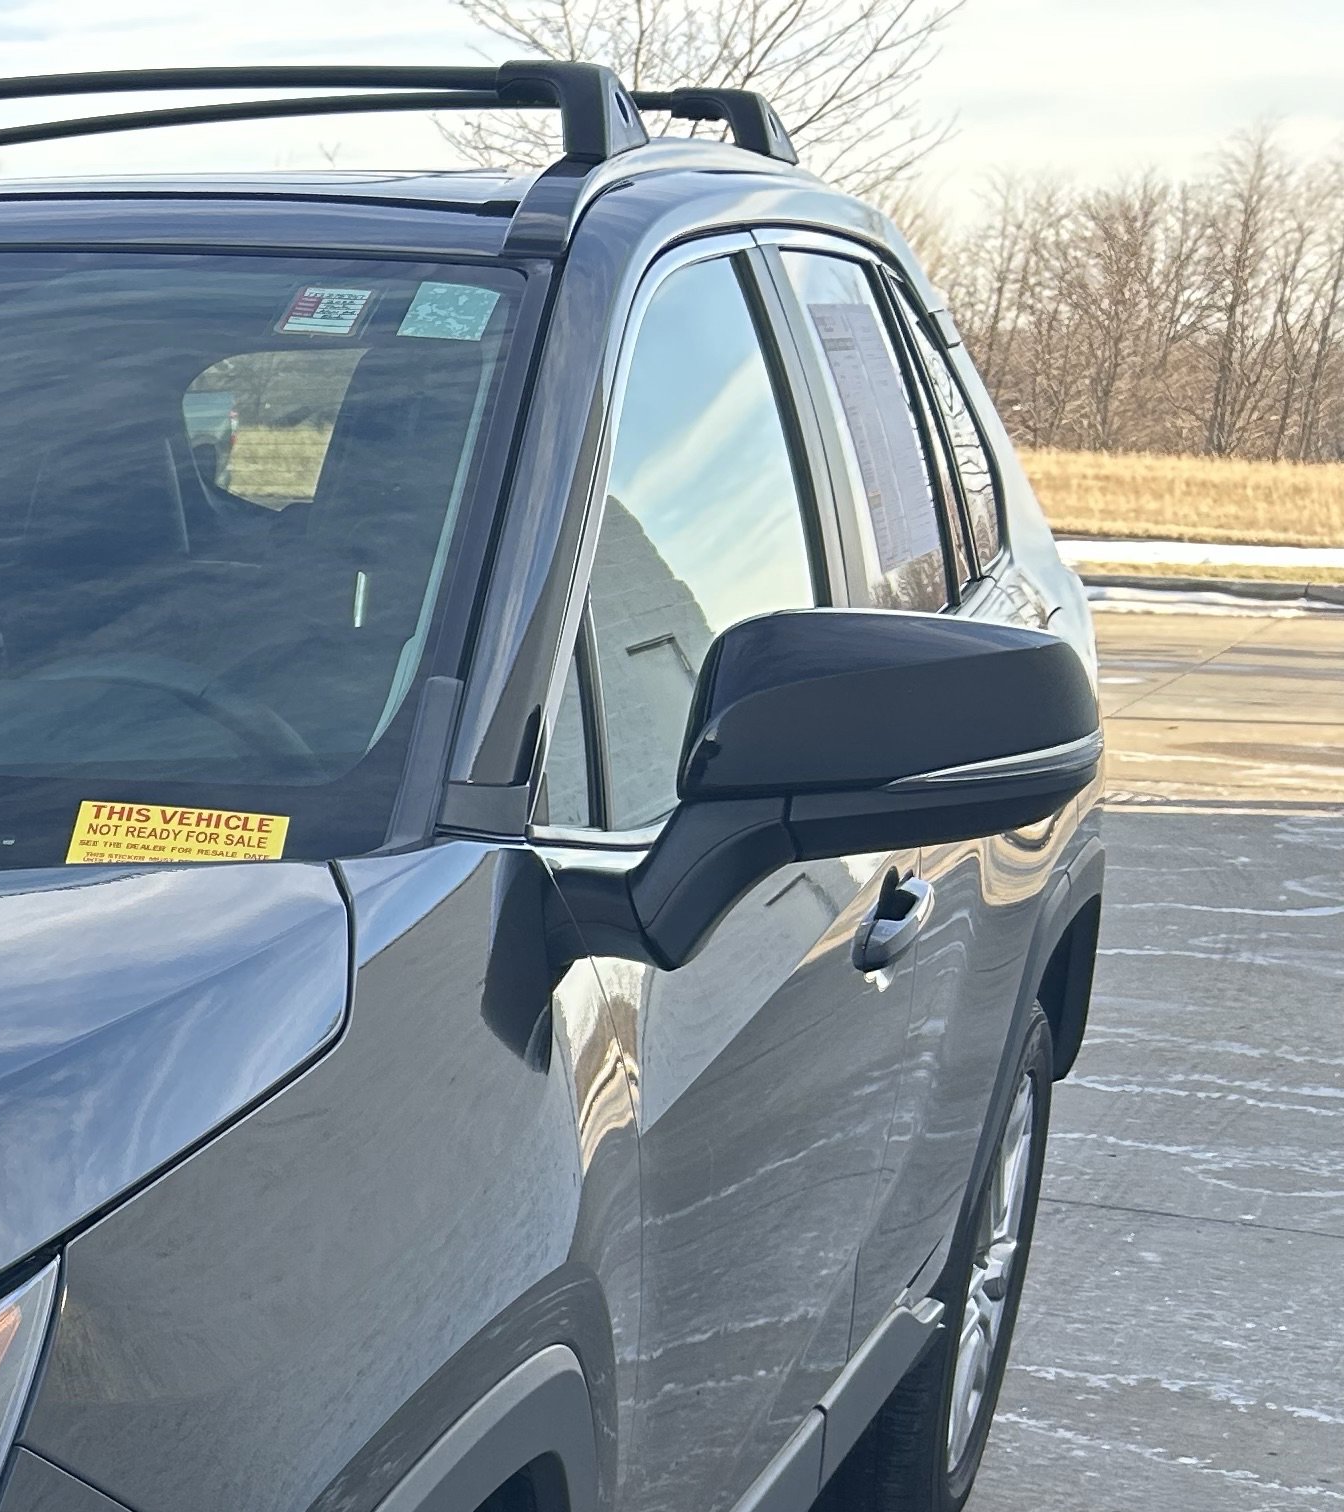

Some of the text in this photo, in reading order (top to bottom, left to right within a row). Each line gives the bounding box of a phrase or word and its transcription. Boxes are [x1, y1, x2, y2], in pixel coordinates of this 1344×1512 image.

[91, 804, 275, 834] THIS VEHICLE
[87, 823, 268, 849] NOT READY FOR SALE
[78, 839, 99, 847] SEE
[126, 843, 166, 852] DEALER
[171, 846, 192, 854] FOR
[197, 849, 238, 858] RESALE
[243, 852, 271, 860] DATE
